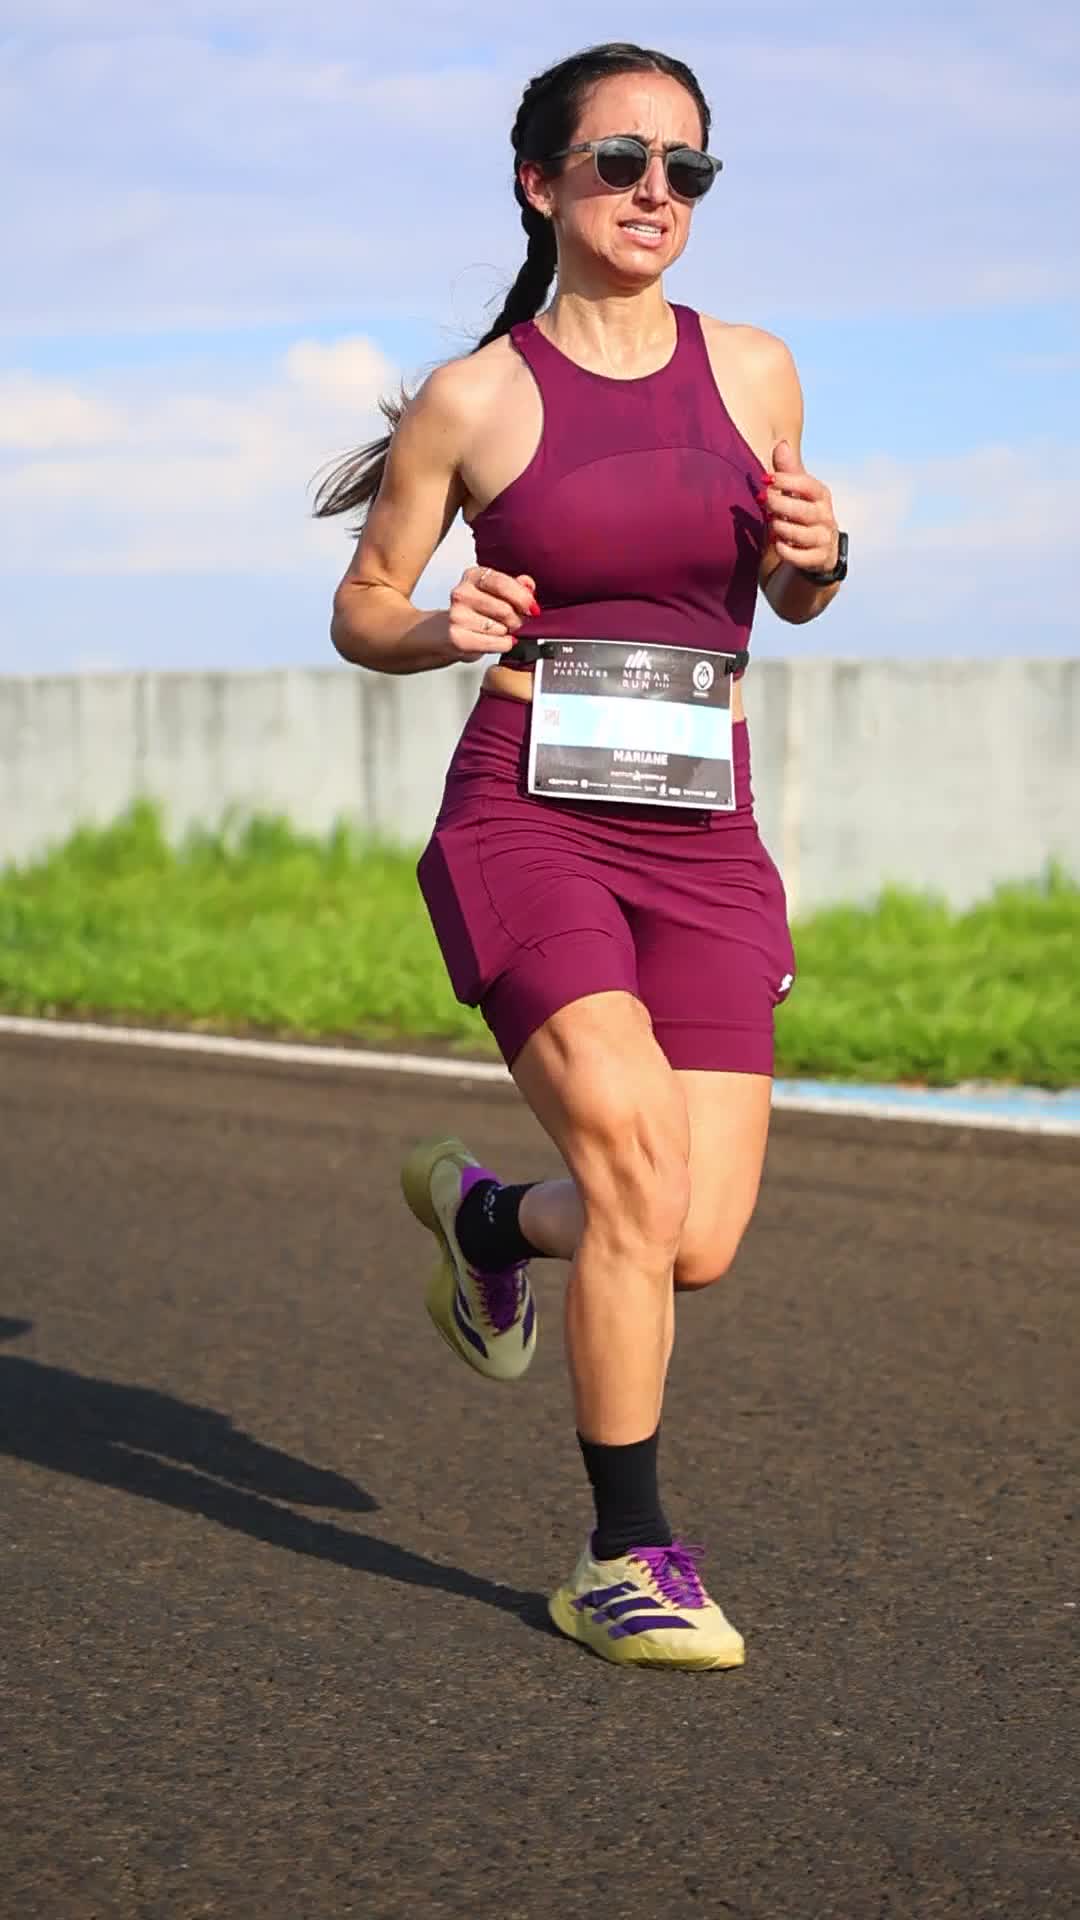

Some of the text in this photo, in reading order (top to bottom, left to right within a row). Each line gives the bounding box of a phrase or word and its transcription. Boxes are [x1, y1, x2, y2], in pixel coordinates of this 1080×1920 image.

[554, 661, 589, 669] MERAK
[553, 669, 608, 678] PARTNERS
[623, 669, 670, 682] MERAK
[622, 680, 649, 690] RUN
[613, 750, 668, 765] MARIANE
